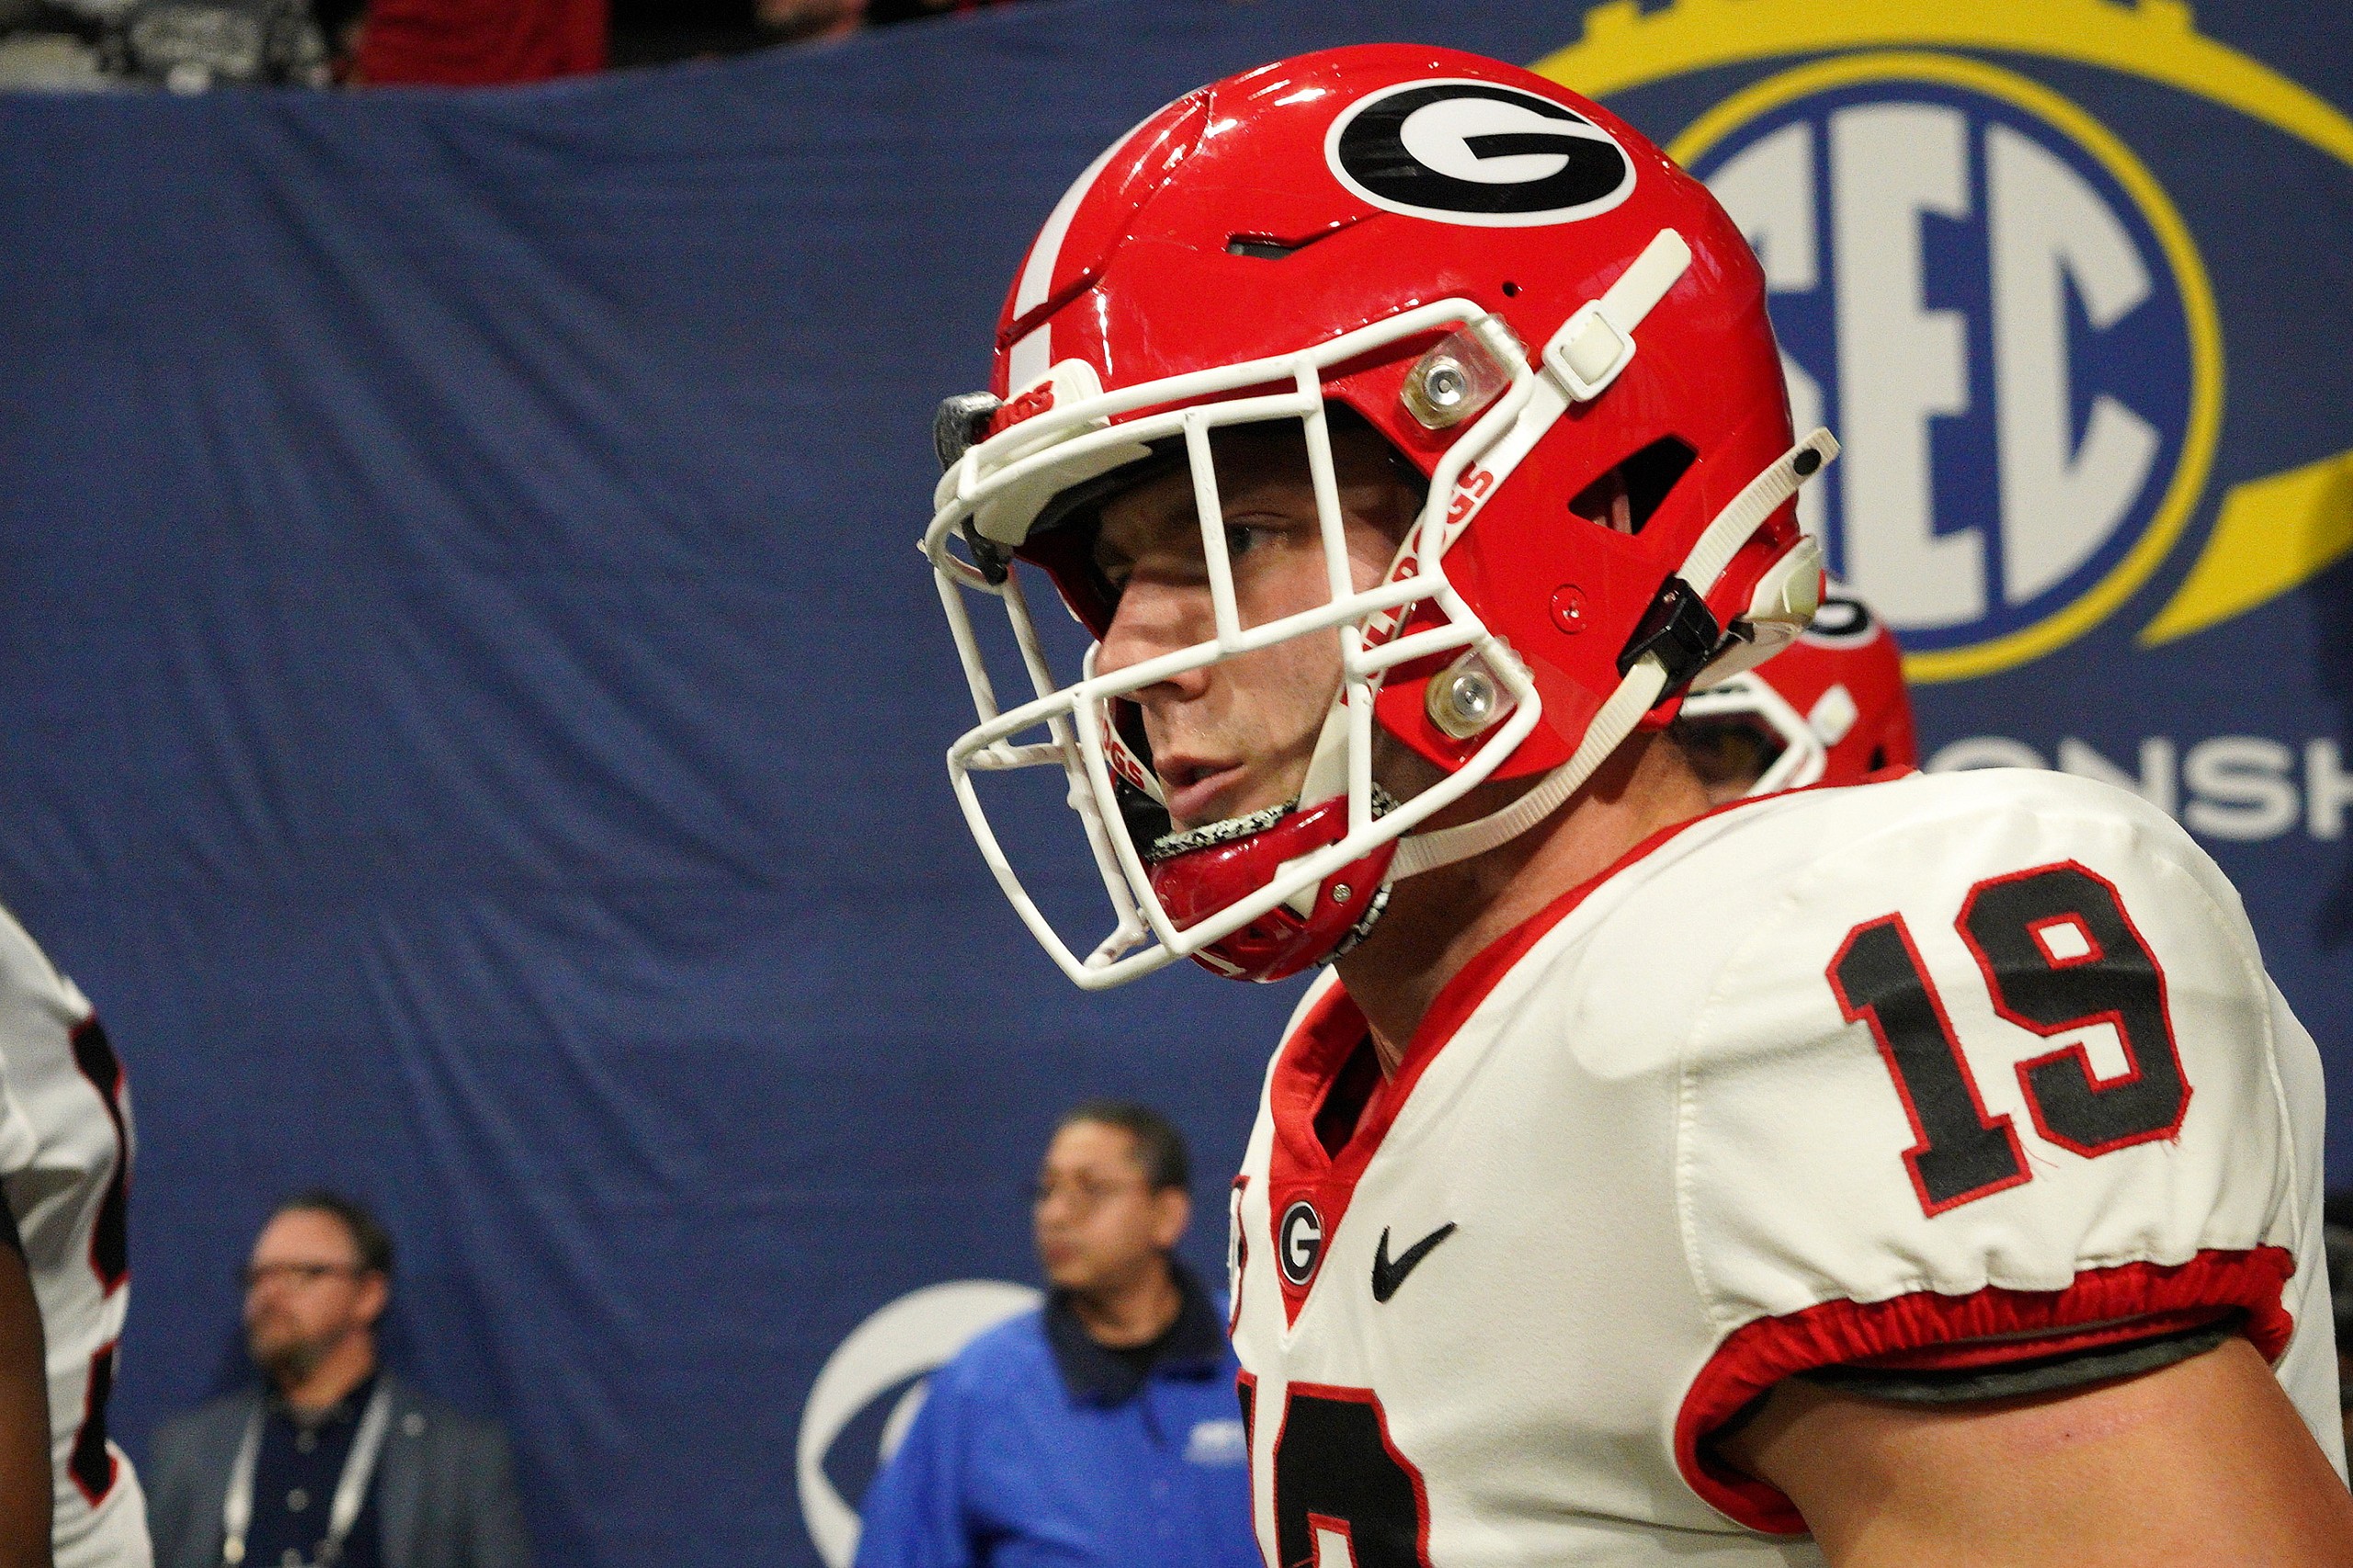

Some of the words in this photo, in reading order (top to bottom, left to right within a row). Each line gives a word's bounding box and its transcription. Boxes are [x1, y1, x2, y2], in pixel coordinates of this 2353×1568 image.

[1333, 80, 1631, 219] G
[1824, 858, 2194, 1220] 19
[1279, 1203, 1322, 1283] G
